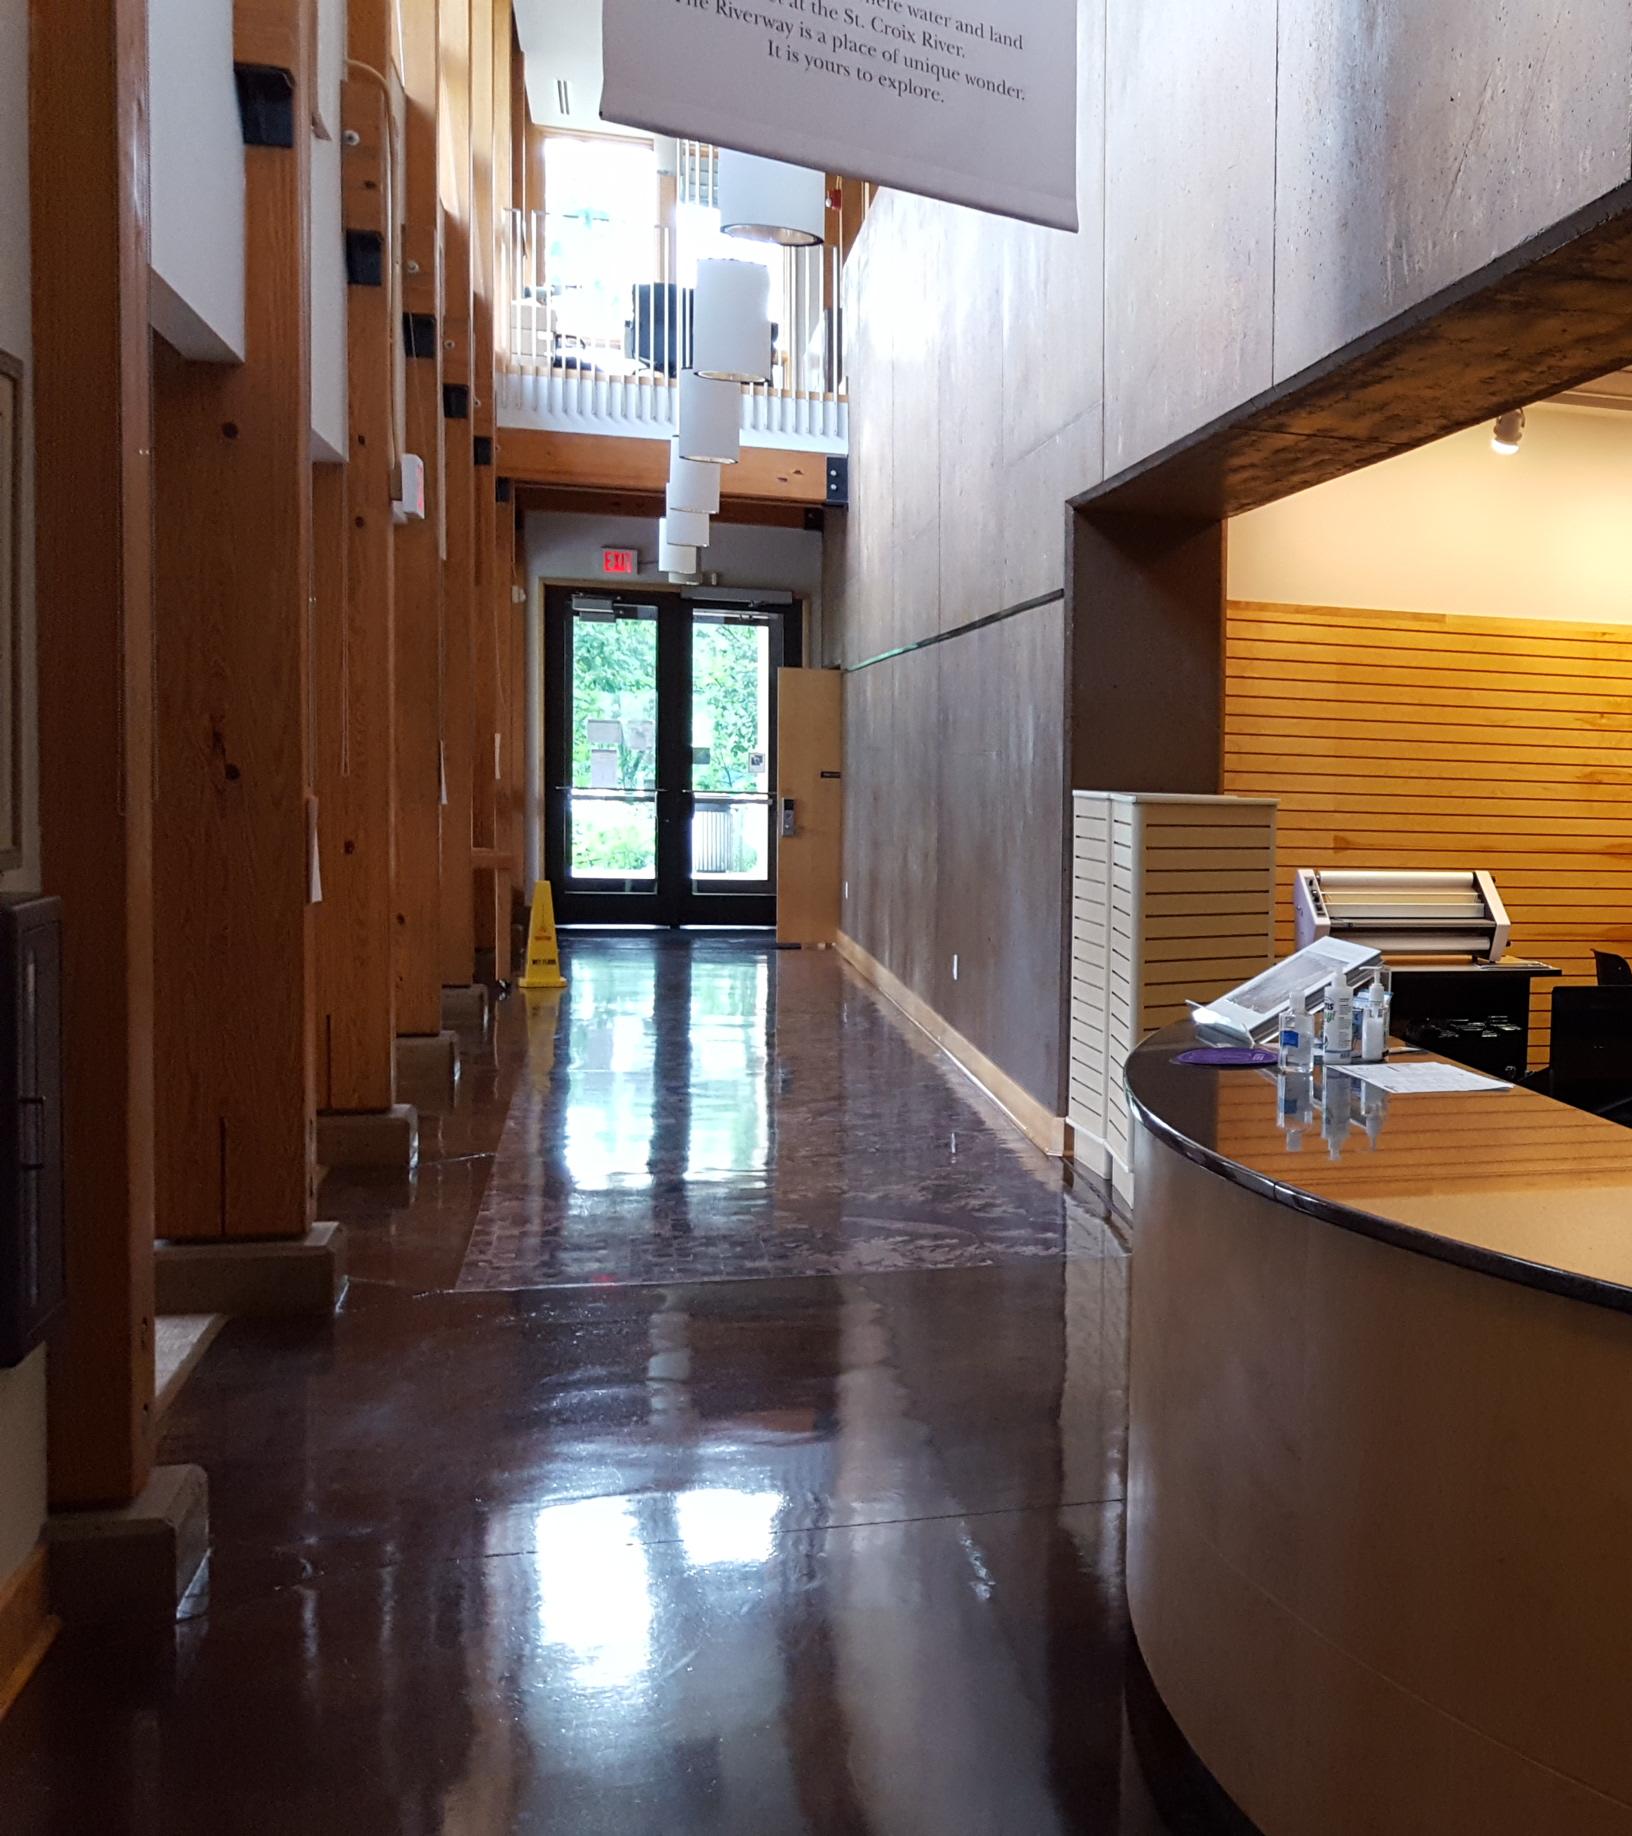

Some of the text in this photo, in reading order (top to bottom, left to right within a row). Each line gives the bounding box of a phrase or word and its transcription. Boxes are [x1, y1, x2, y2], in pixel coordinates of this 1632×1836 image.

[716, 0, 1025, 100] Riverway is a place of unique wonder.
[811, 0, 838, 20] the
[843, 8, 865, 29] St.
[871, 16, 916, 43] Croix
[922, 31, 965, 58] River.
[908, 5, 951, 27] water
[955, 19, 984, 39] and
[990, 25, 1024, 50] land
[768, 39, 945, 103] It is yours to explore.
